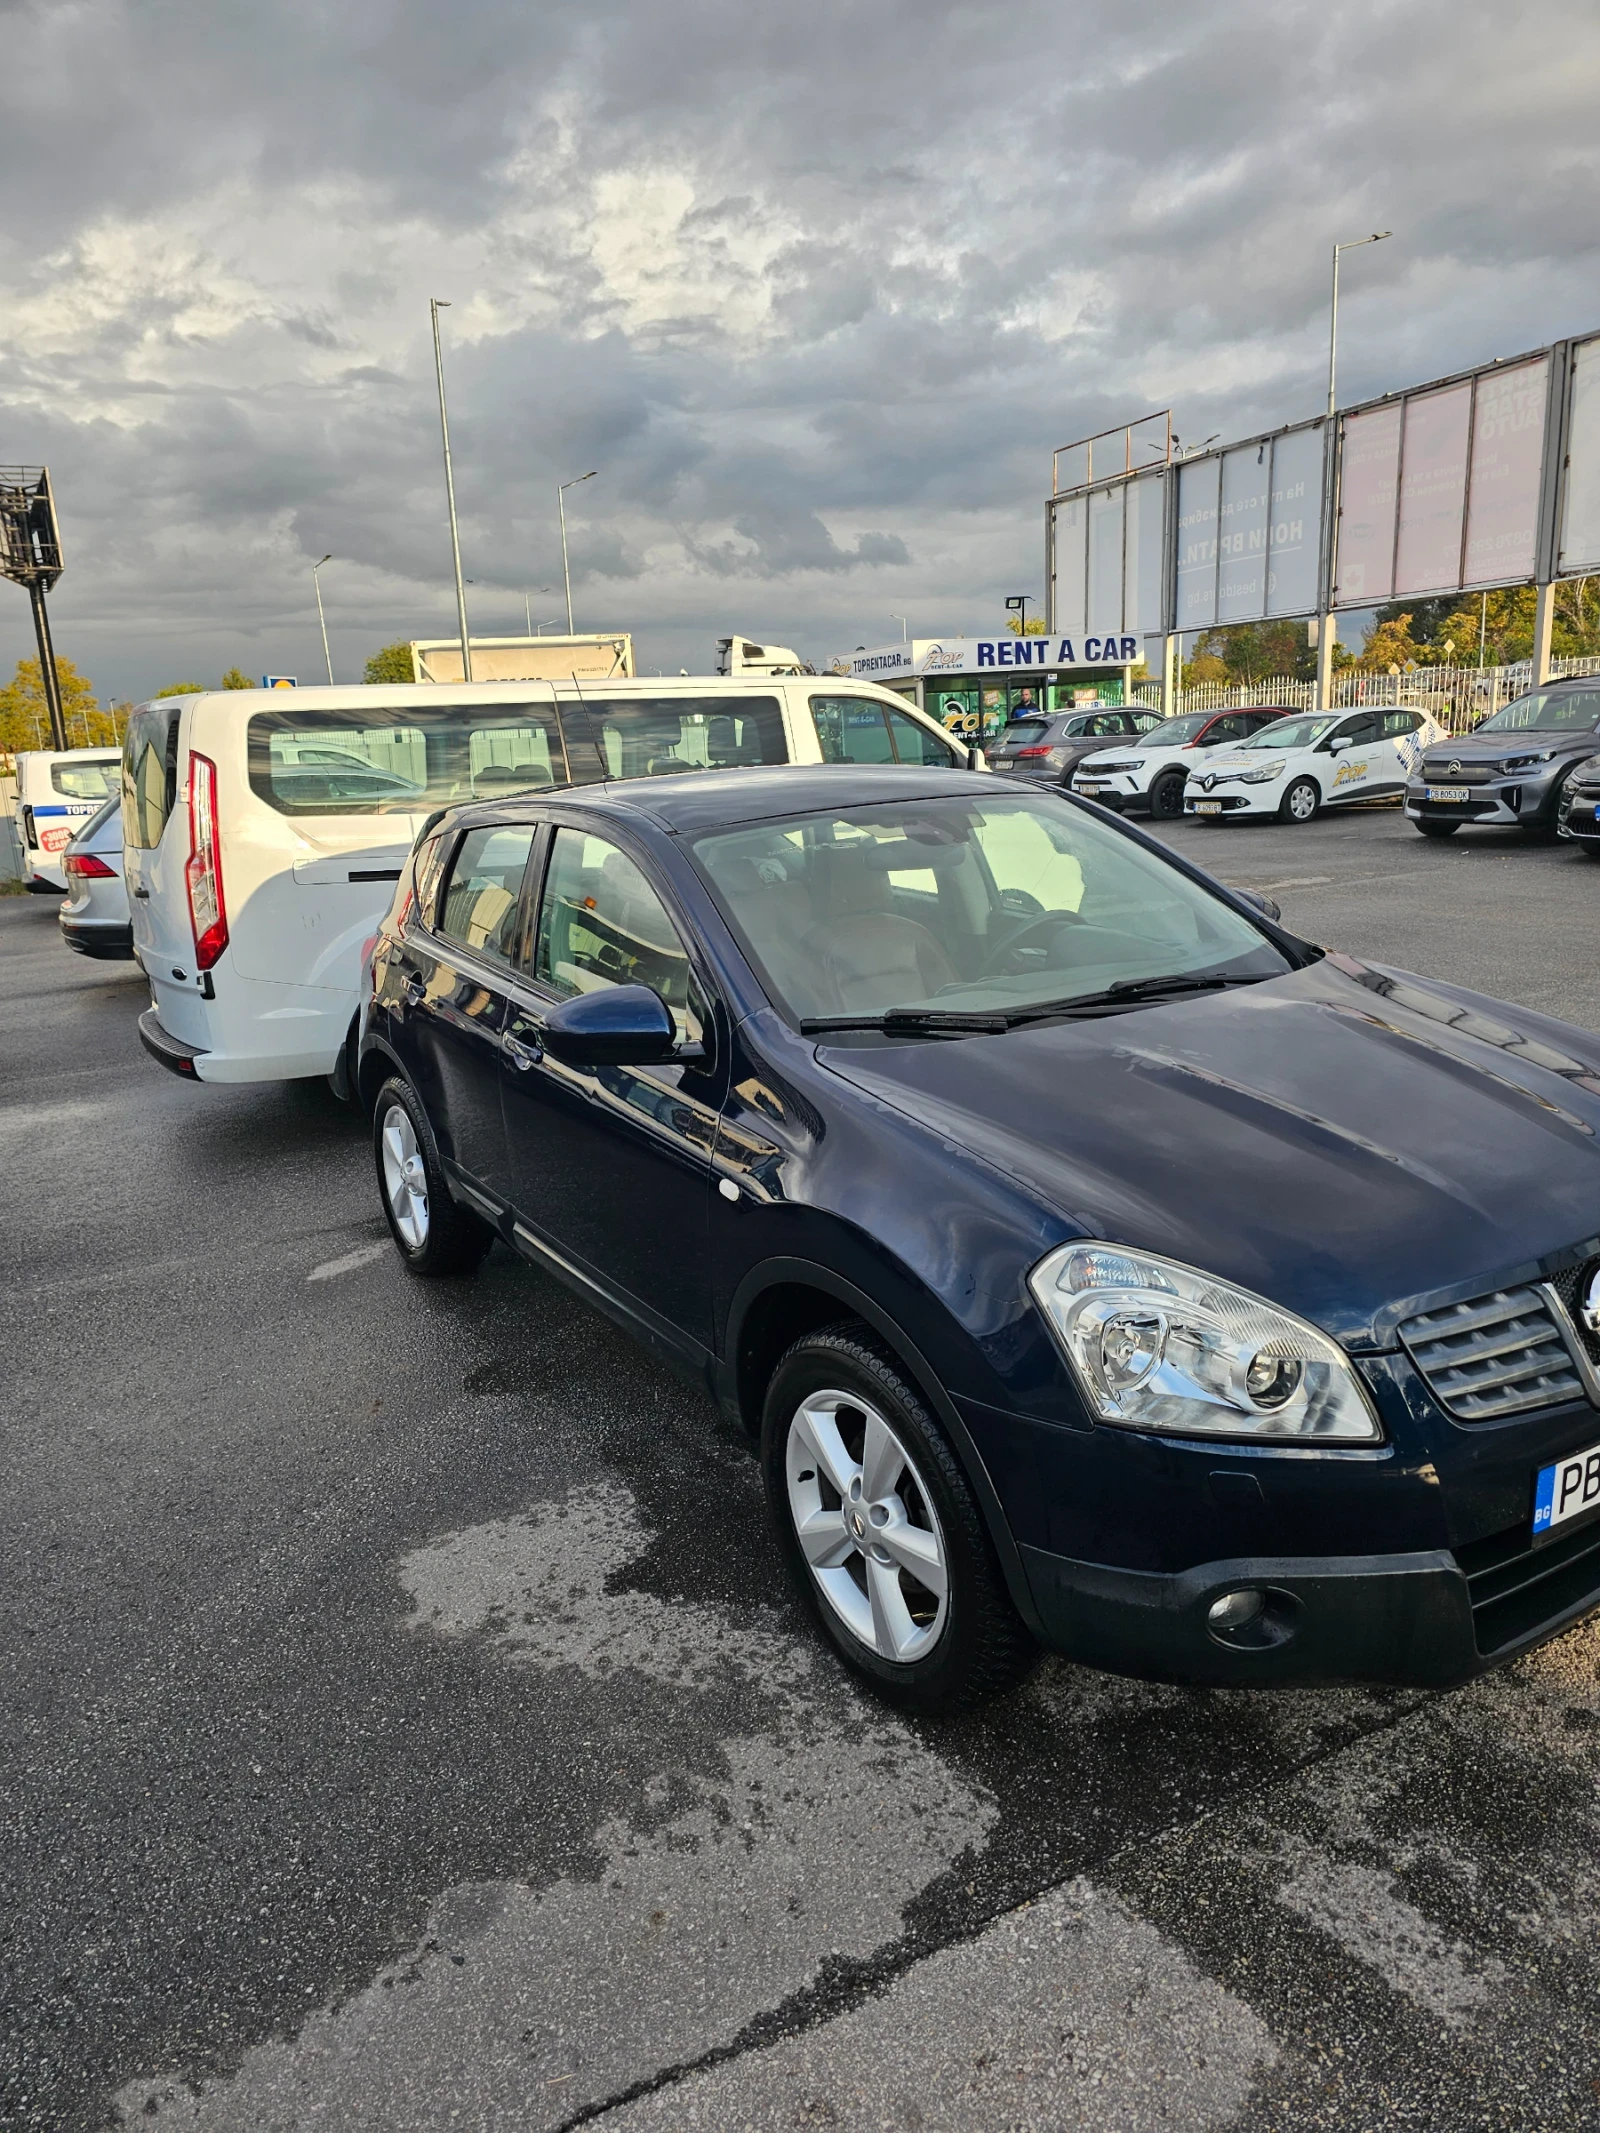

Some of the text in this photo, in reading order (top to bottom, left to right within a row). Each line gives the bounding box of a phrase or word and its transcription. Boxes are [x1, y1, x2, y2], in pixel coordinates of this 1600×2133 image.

[922, 651, 965, 672] TOP
[977, 637, 1137, 667] RENT A CAR
[1332, 764, 1368, 787] TOP
[1559, 1452, 1600, 1514] PB
[1534, 1504, 1551, 1524] BG
